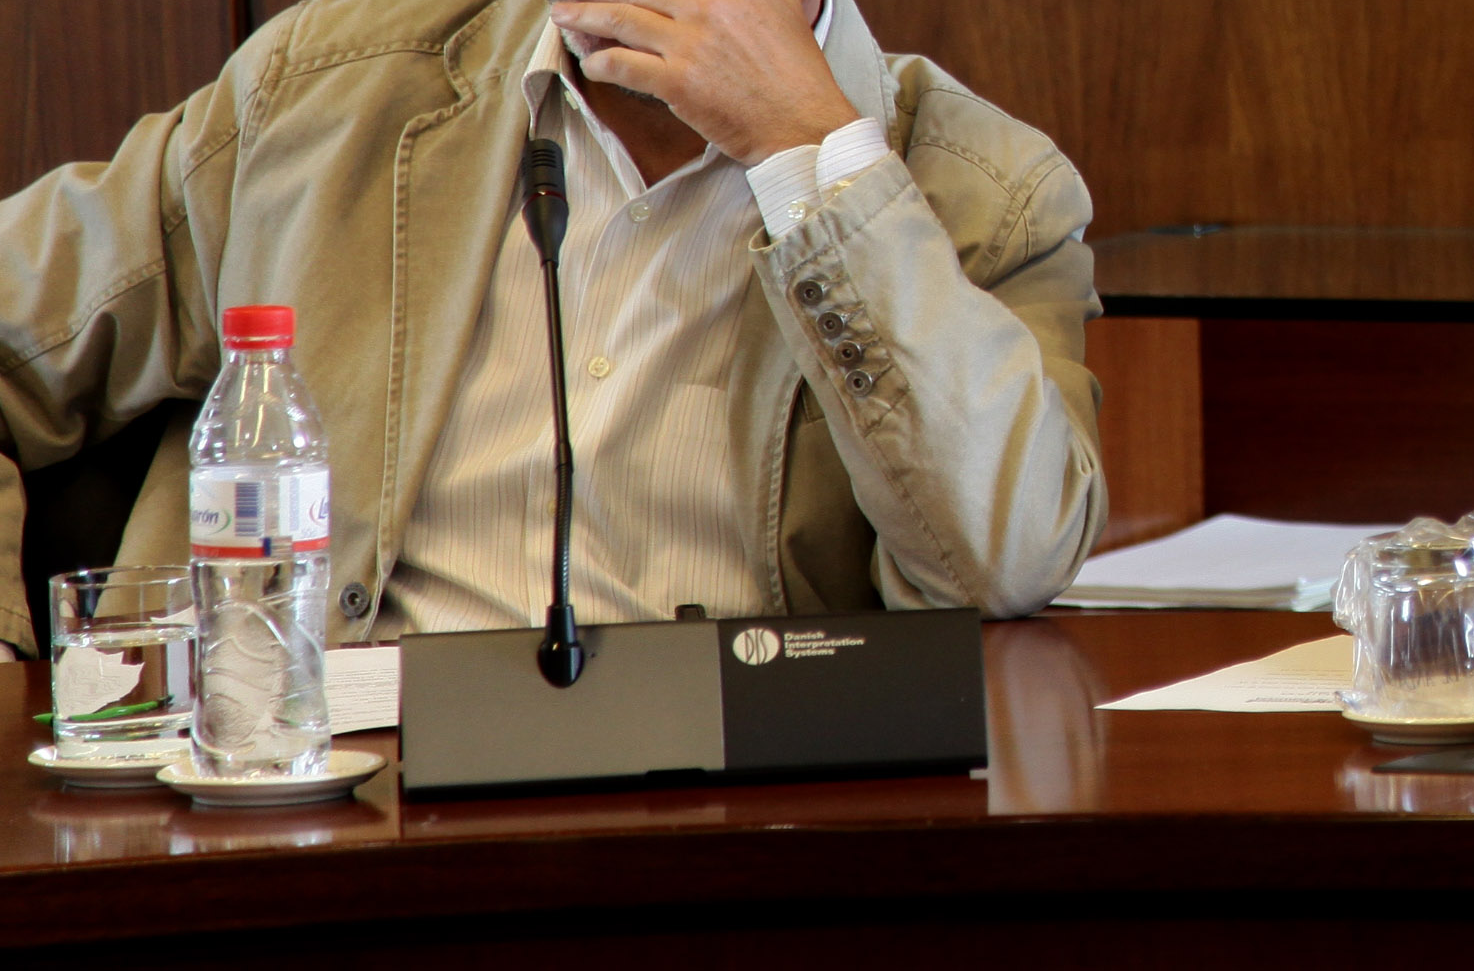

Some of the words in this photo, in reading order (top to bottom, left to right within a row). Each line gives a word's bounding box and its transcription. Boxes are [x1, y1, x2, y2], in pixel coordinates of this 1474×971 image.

[784, 631, 825, 641] Danish
[784, 638, 865, 649] Interpretation
[785, 648, 836, 659] Systems
